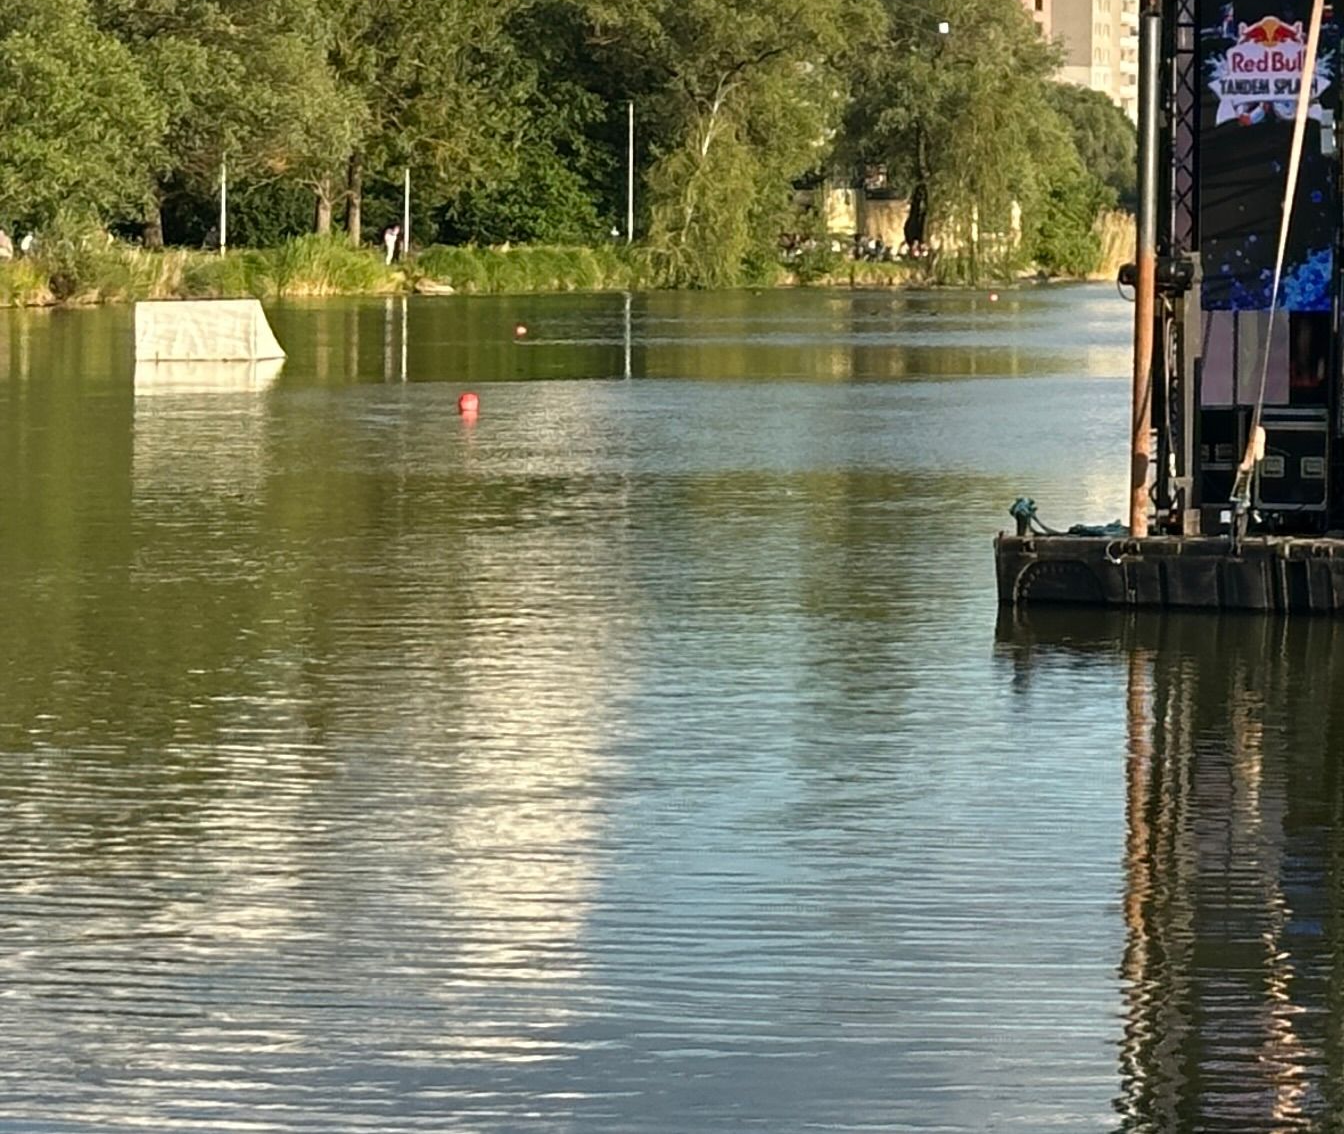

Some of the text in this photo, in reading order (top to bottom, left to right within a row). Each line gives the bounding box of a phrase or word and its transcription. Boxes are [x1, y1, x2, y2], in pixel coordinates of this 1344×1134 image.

[1232, 51, 1268, 72] Red
[1220, 78, 1318, 95] TANDEM SPLAH
